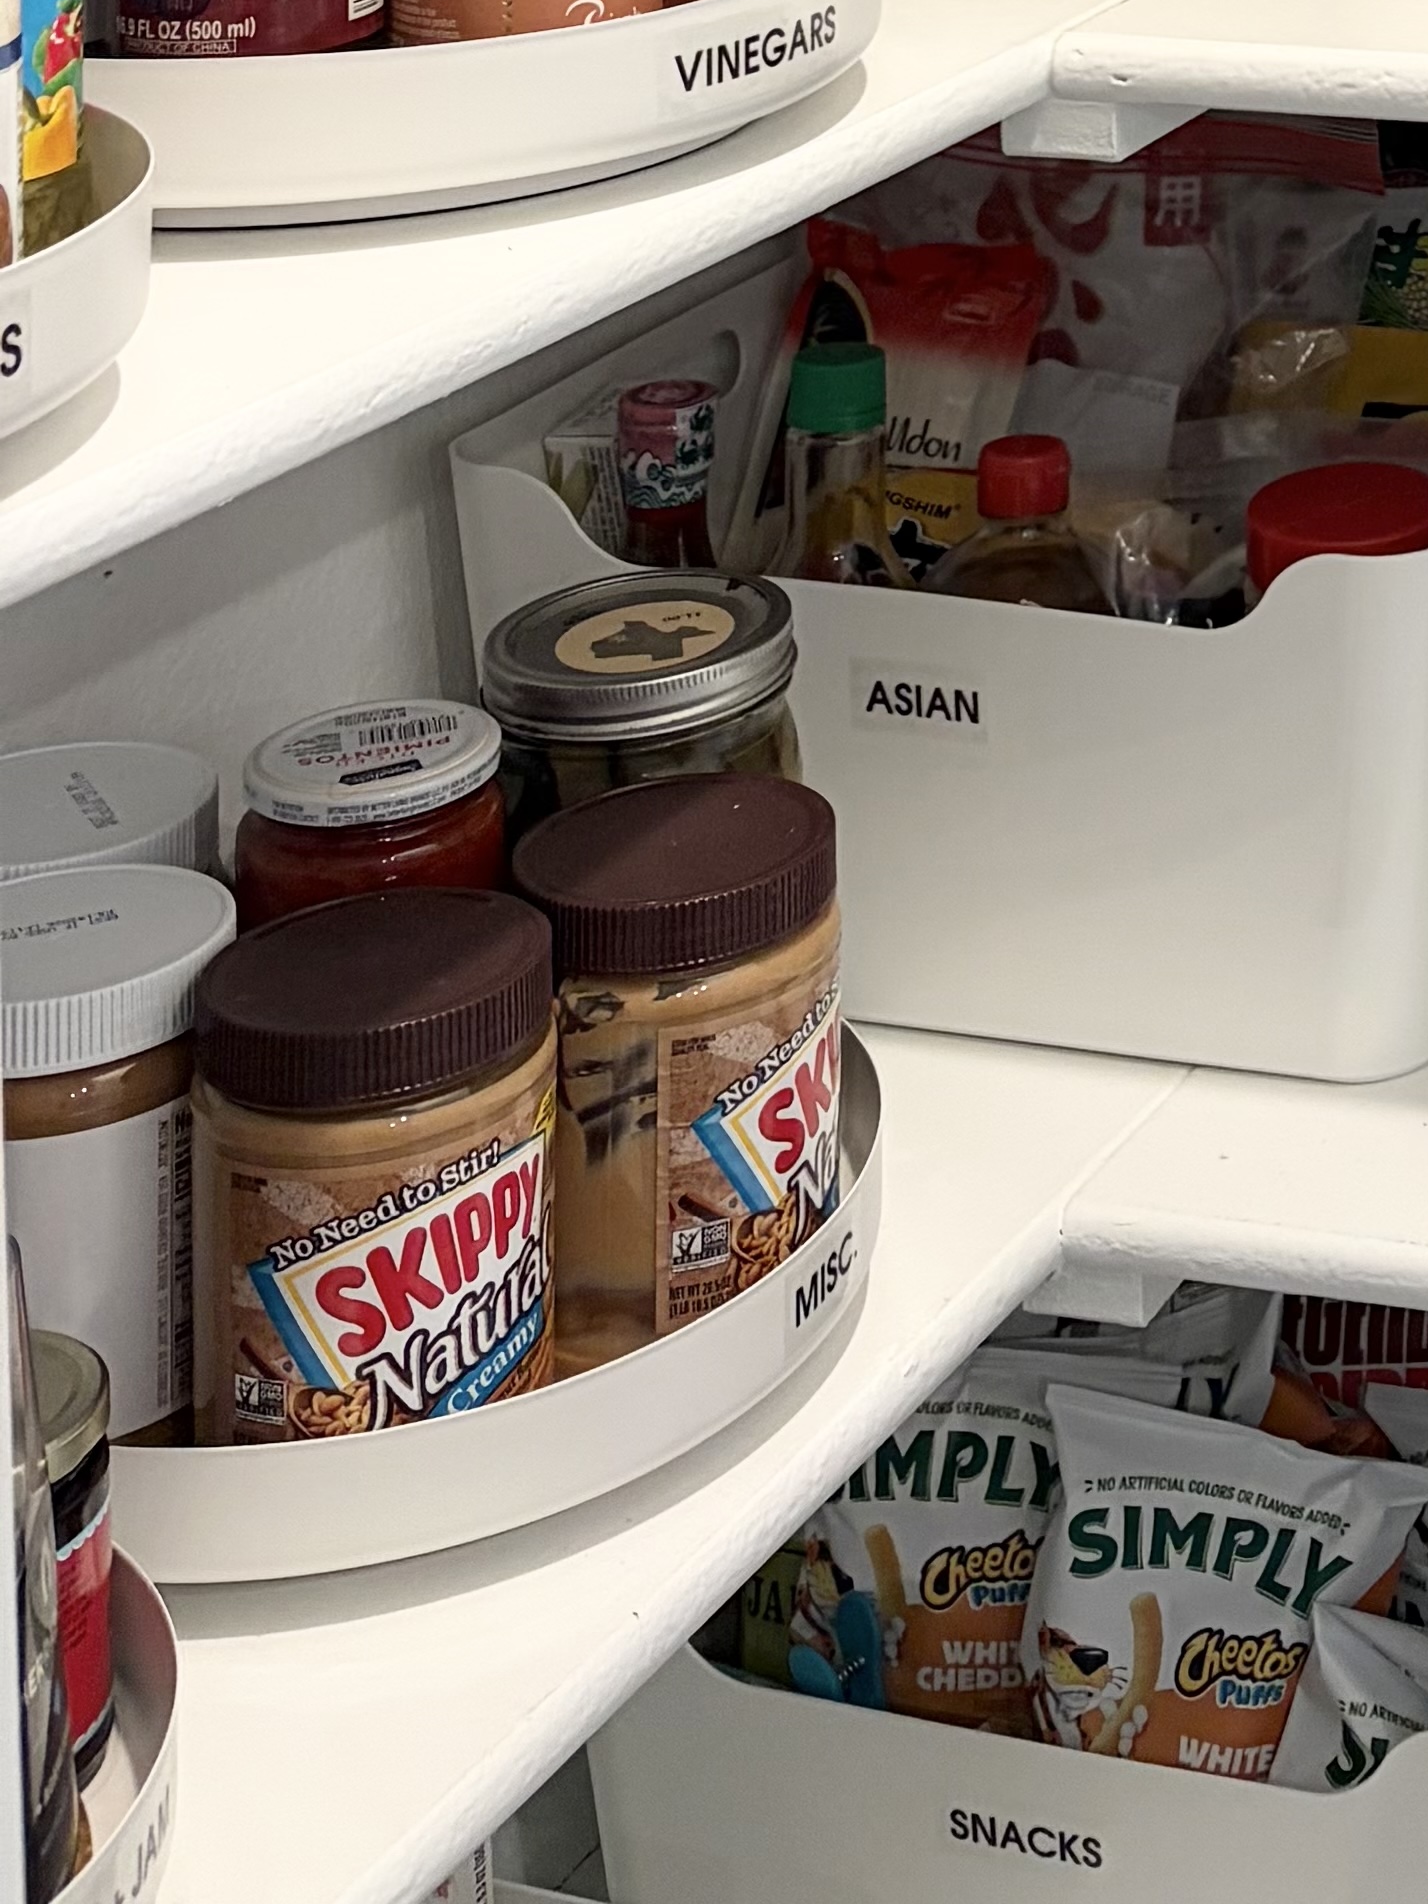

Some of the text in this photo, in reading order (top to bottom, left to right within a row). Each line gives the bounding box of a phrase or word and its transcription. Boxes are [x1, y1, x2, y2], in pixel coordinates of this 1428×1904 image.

[674, 4, 837, 93] VINEGARS
[865, 680, 981, 725] ASIAN
[271, 1137, 501, 1270] No Need to Stir!
[315, 1152, 541, 1358] SKIPPY
[795, 1231, 859, 1329] MISC.
[1067, 1505, 1353, 1621] SIMPLY
[1178, 1630, 1303, 1695] Cheetos
[949, 1808, 1103, 1869] SNACKS
